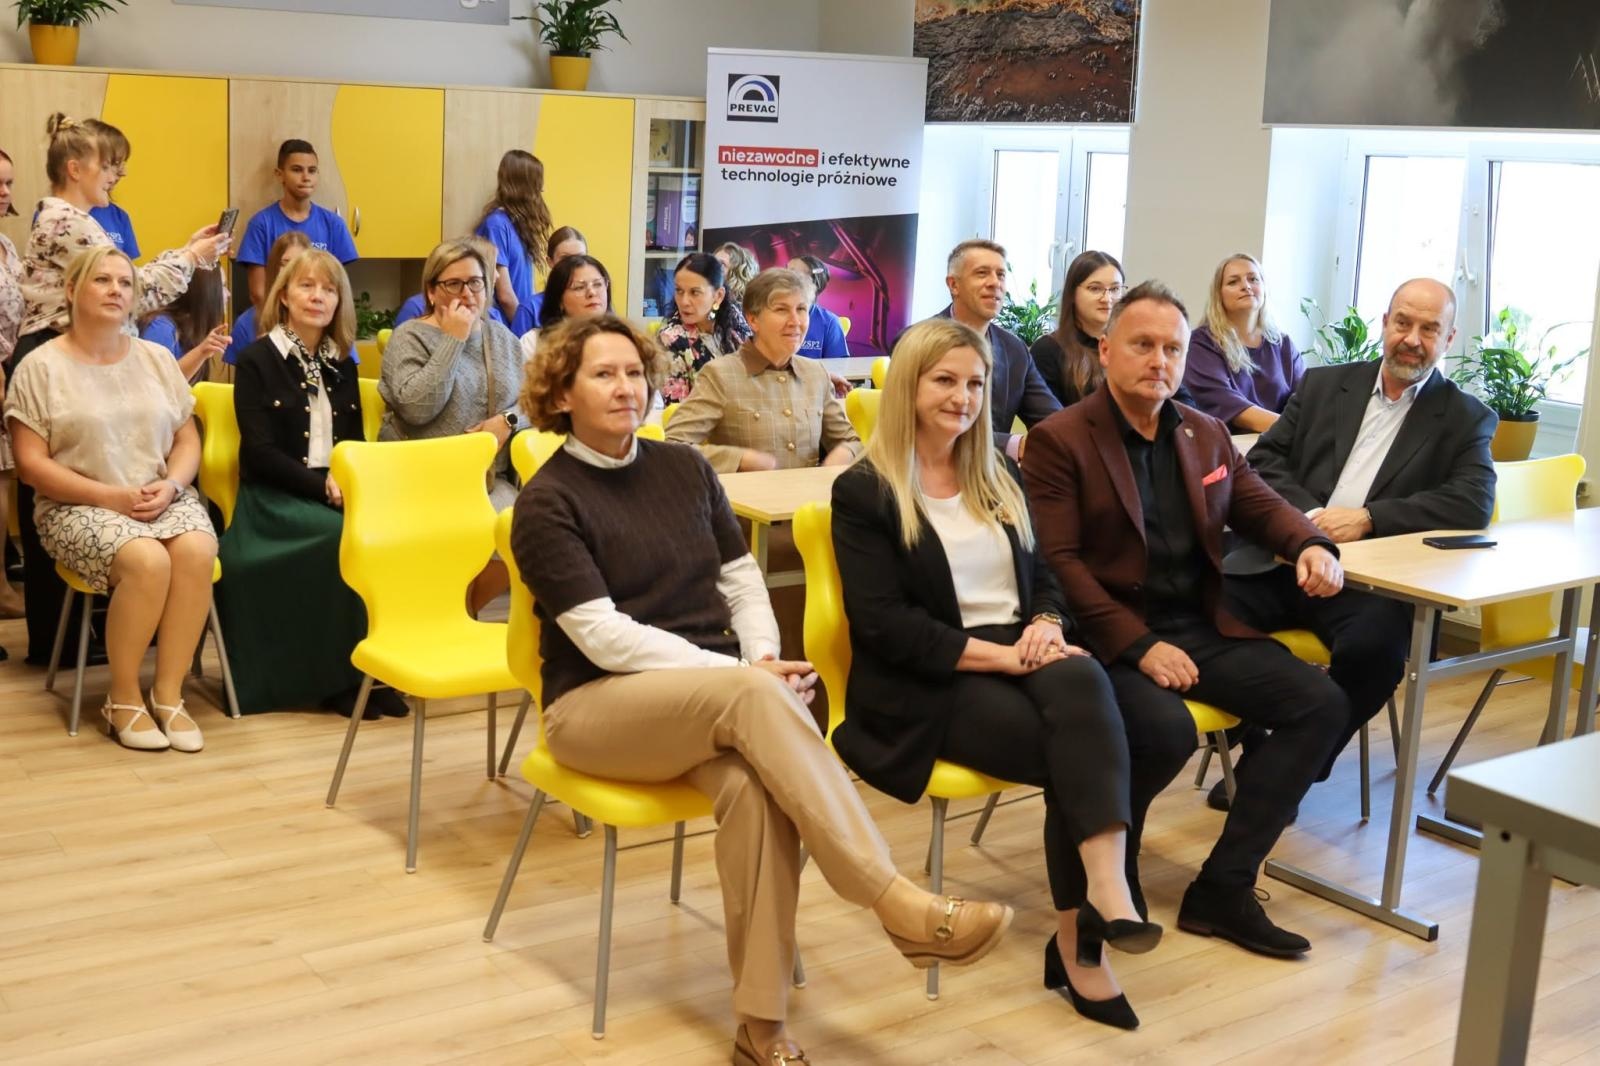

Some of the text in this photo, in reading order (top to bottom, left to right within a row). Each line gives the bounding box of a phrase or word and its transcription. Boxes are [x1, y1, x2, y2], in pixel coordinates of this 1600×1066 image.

[730, 103, 776, 113] PREVAC
[721, 148, 911, 170] niezawodne i efektywne
[721, 168, 897, 187] technologie próżniowe
